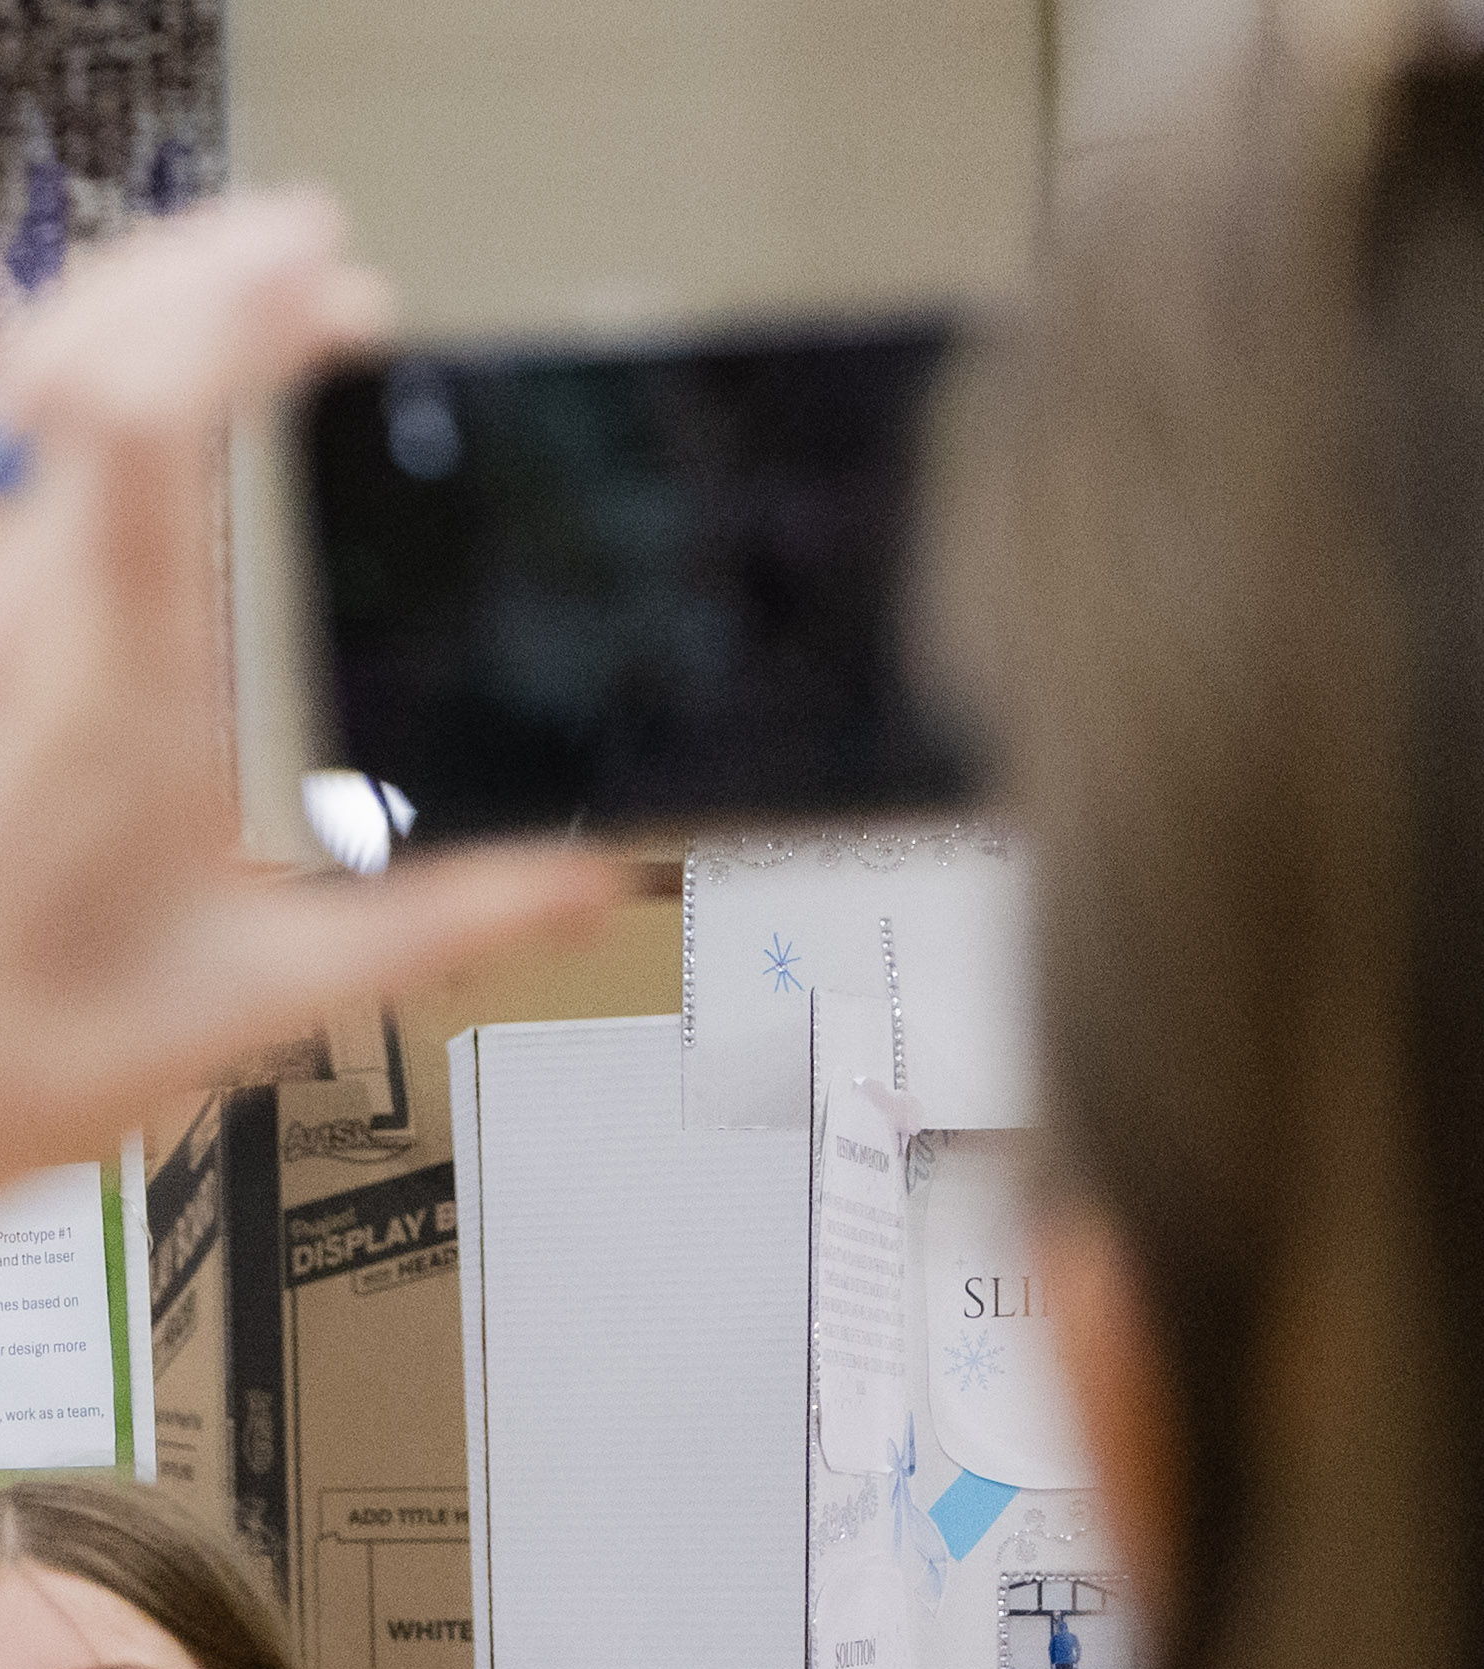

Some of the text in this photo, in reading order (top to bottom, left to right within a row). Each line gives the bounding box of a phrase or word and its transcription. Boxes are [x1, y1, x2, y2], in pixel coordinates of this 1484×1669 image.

[59, 1227, 73, 1241] #1
[22, 1253, 41, 1267] the
[44, 1251, 76, 1265] laser
[6, 1406, 106, 1424] work as a team,
